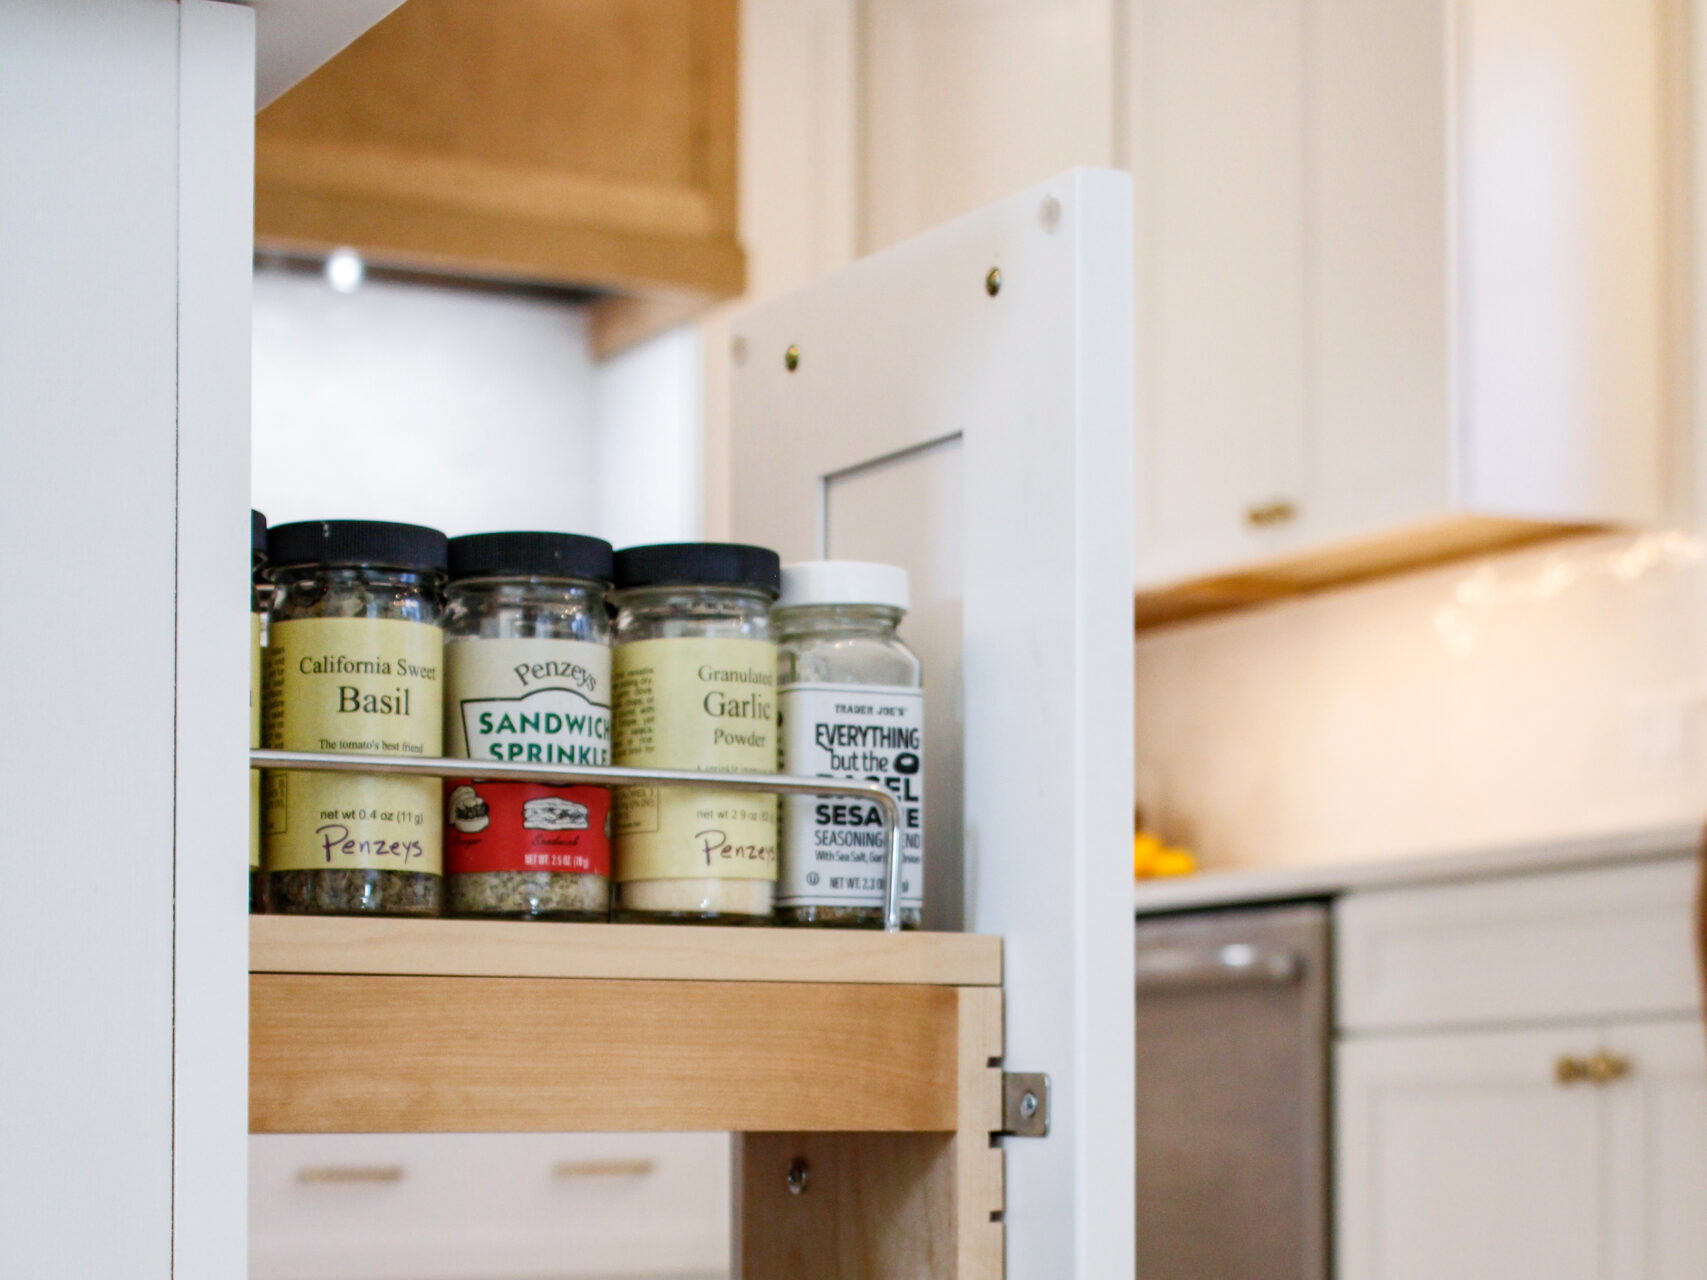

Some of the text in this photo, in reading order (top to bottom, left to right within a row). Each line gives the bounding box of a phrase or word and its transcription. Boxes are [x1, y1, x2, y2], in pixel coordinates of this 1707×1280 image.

[299, 655, 436, 680] California Sweet
[513, 660, 597, 692] Penzeys
[698, 664, 773, 686] Granulated
[337, 685, 410, 716] Basil
[703, 690, 771, 720] Garlic
[835, 704, 906, 716] TRADER JOE'S
[479, 711, 610, 741] SANDWICH
[714, 728, 766, 747] Powder
[815, 722, 920, 750] EVERYTHING
[319, 738, 424, 754] The tomato's best friend
[830, 750, 889, 773] but the
[320, 809, 338, 820] net
[341, 809, 355, 820] wt
[358, 809, 377, 820] 0.4
[380, 811, 394, 821] oz
[696, 810, 713, 820] net
[815, 803, 919, 829] SESAE
[315, 824, 423, 865] Penzeys
[814, 829, 883, 848] SEASONING
